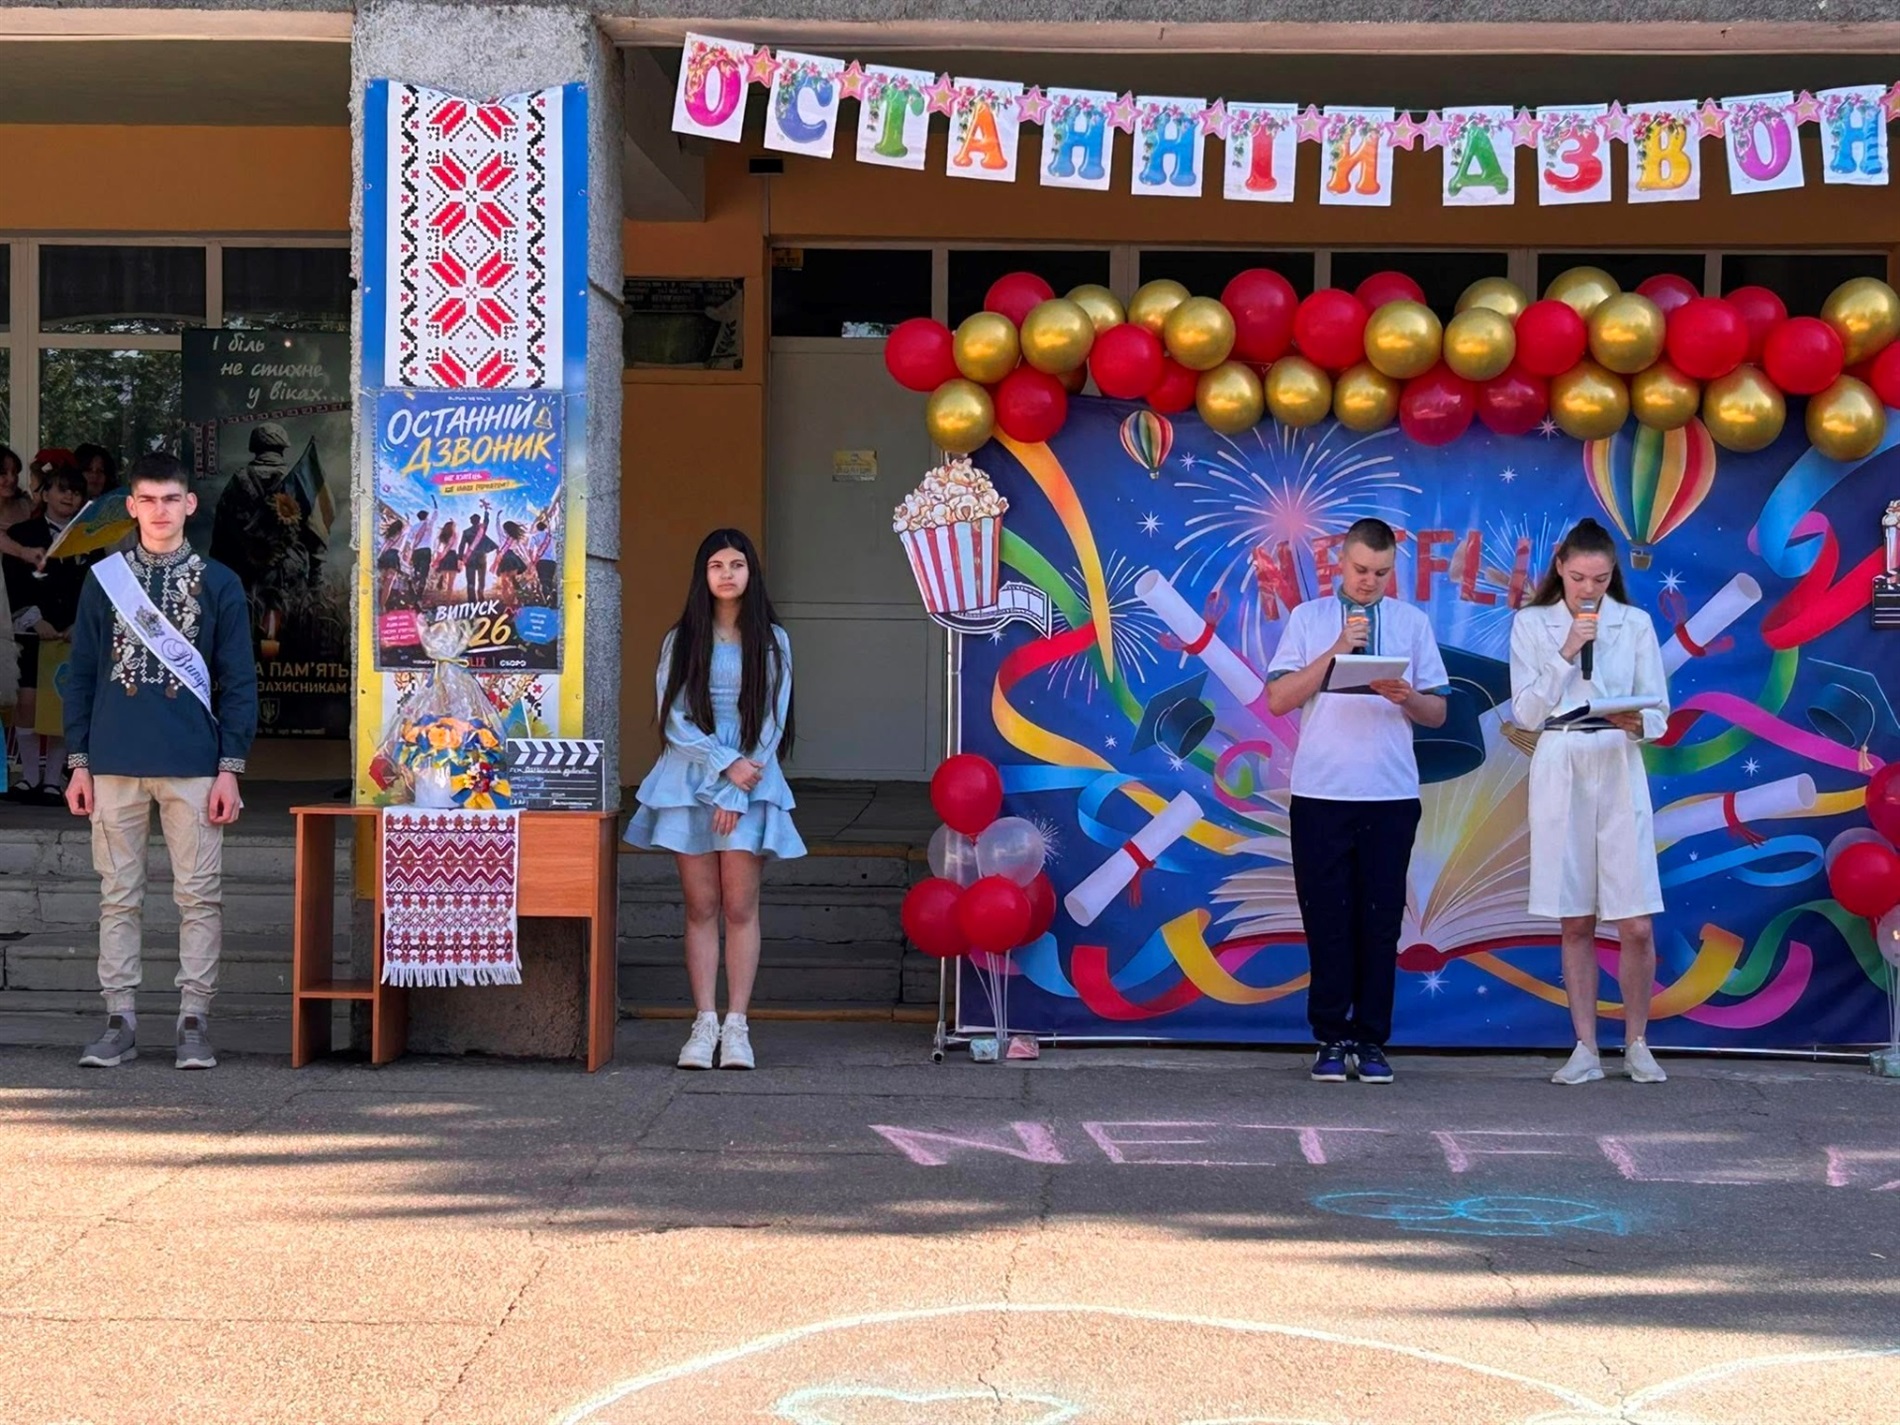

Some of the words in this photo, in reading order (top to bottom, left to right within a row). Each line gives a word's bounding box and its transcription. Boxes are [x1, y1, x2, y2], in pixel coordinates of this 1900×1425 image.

[212, 335, 219, 351] І
[228, 332, 265, 352] біль
[220, 362, 244, 376] не
[251, 364, 324, 378] стихне
[246, 386, 261, 409] у
[387, 394, 537, 445] ОСТАННІЙ
[401, 431, 556, 478] ДЗВОНИК
[1253, 529, 1562, 620] NEFLI
[434, 600, 500, 622] ВИПУСК
[269, 661, 350, 678] ПАМ'ЯТЬ
